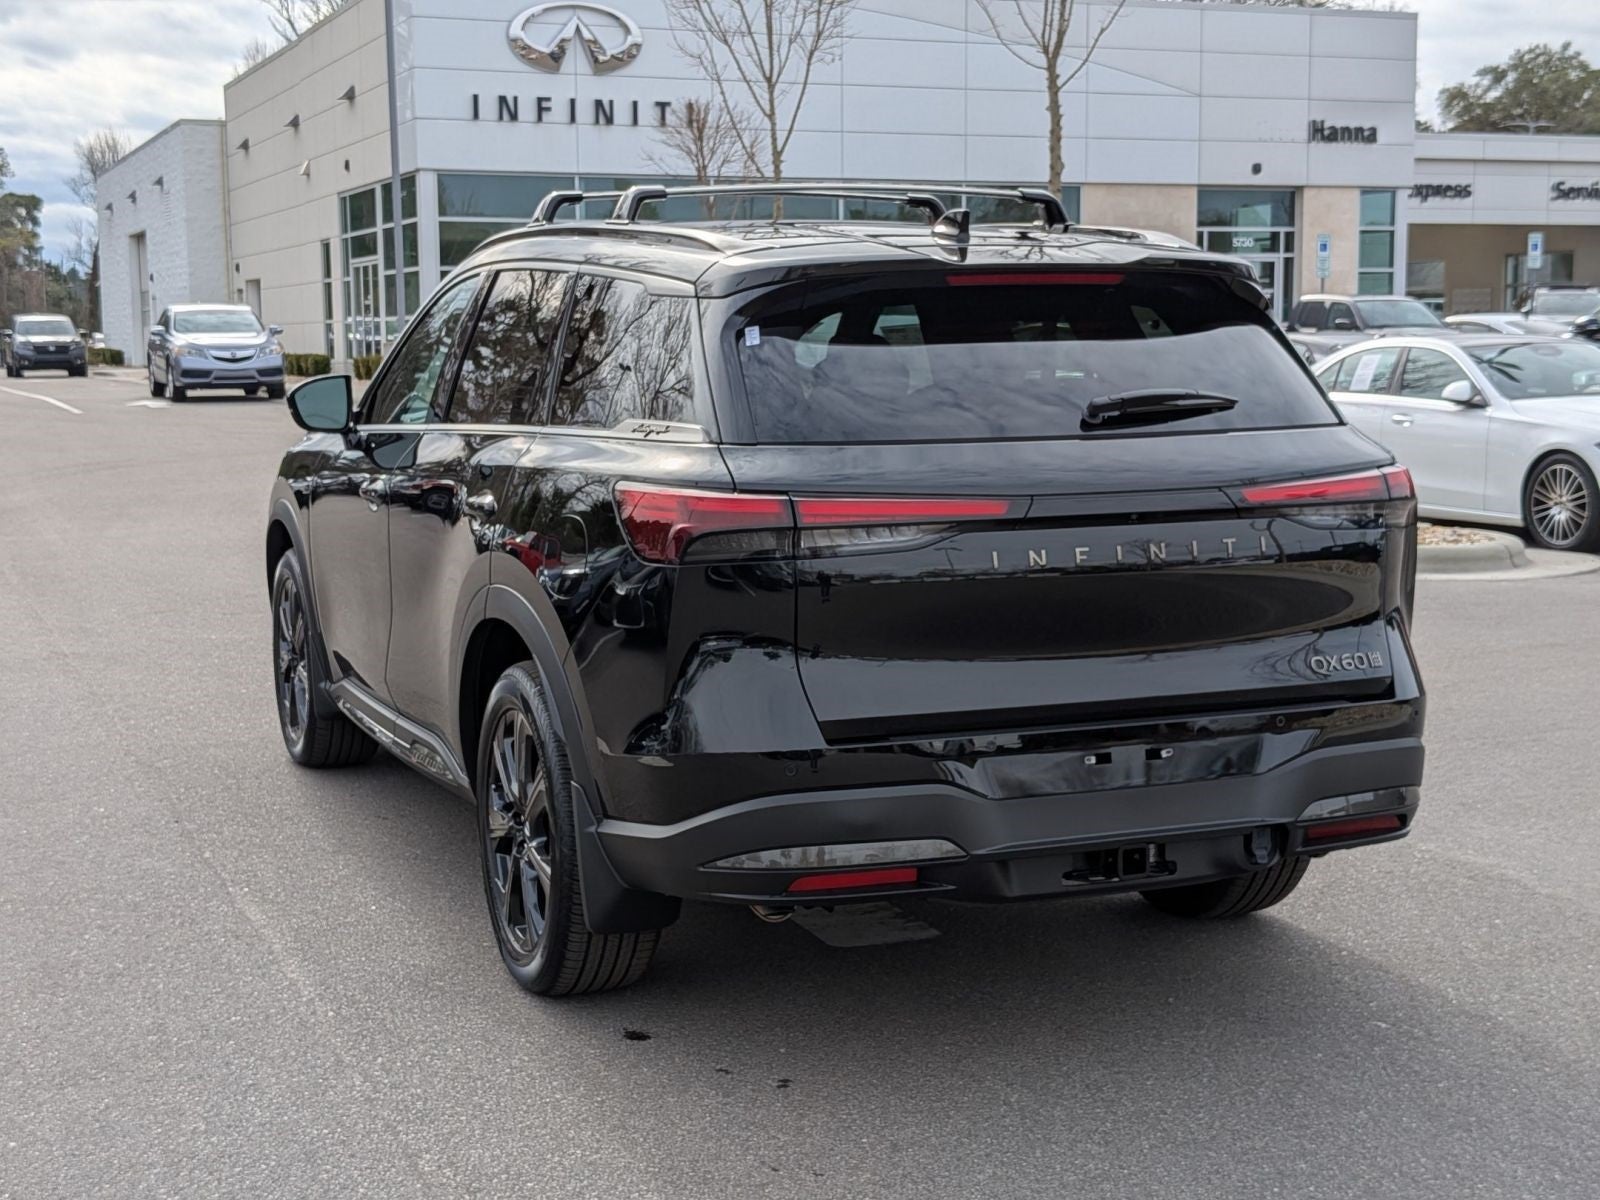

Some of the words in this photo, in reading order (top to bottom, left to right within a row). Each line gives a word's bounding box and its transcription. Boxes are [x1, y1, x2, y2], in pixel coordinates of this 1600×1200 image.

[1309, 119, 1377, 143] Hanna
[991, 535, 1268, 569] INFINITI
[1310, 652, 1367, 676] QX60
